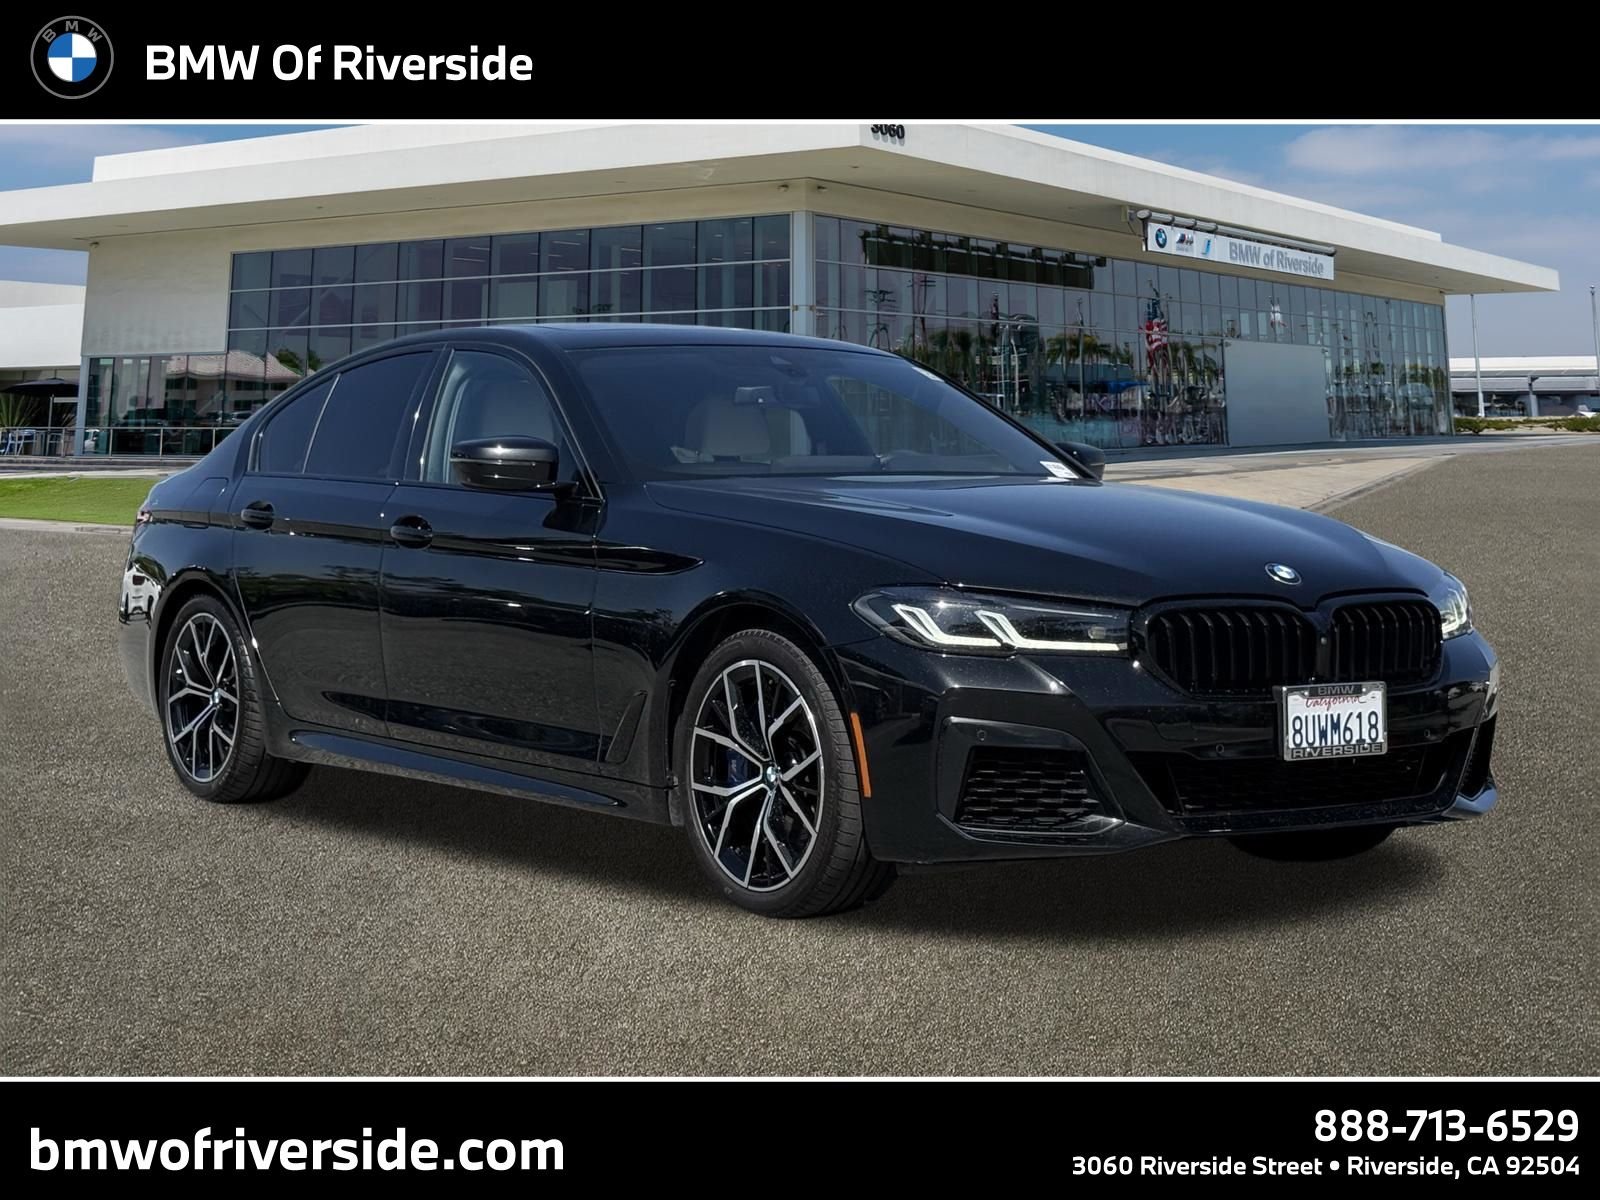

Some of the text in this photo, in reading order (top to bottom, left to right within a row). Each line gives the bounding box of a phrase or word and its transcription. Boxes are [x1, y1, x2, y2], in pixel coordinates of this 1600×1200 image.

[1228, 240, 1324, 275] BMW of Riverside
[1318, 686, 1354, 695] BMW
[1292, 710, 1379, 747] 8UWM618
[1293, 743, 1381, 758] RIVERSIDE
